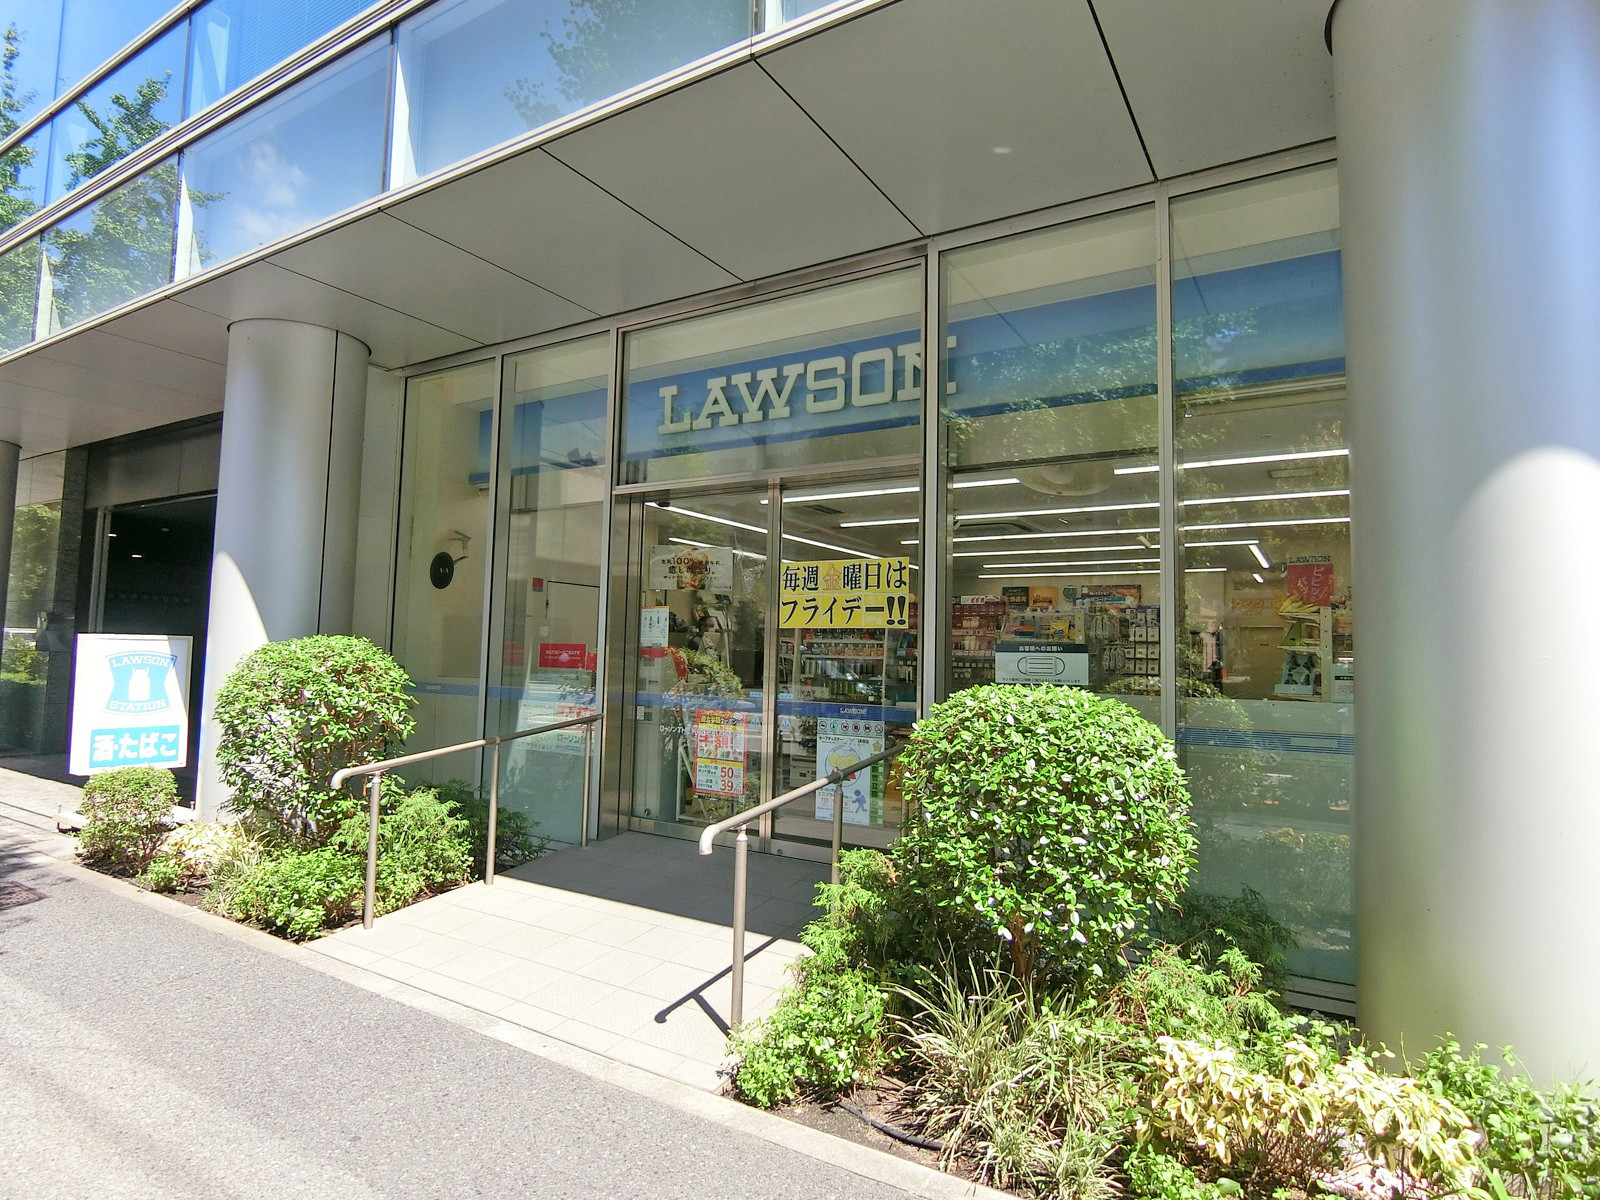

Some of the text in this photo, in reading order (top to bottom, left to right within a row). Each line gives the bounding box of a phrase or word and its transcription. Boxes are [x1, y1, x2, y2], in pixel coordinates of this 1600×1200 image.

[658, 335, 957, 435] LAWSON
[782, 560, 908, 591] 毎週金曜日は
[111, 654, 170, 667] LAWSON
[109, 698, 167, 712] STATION
